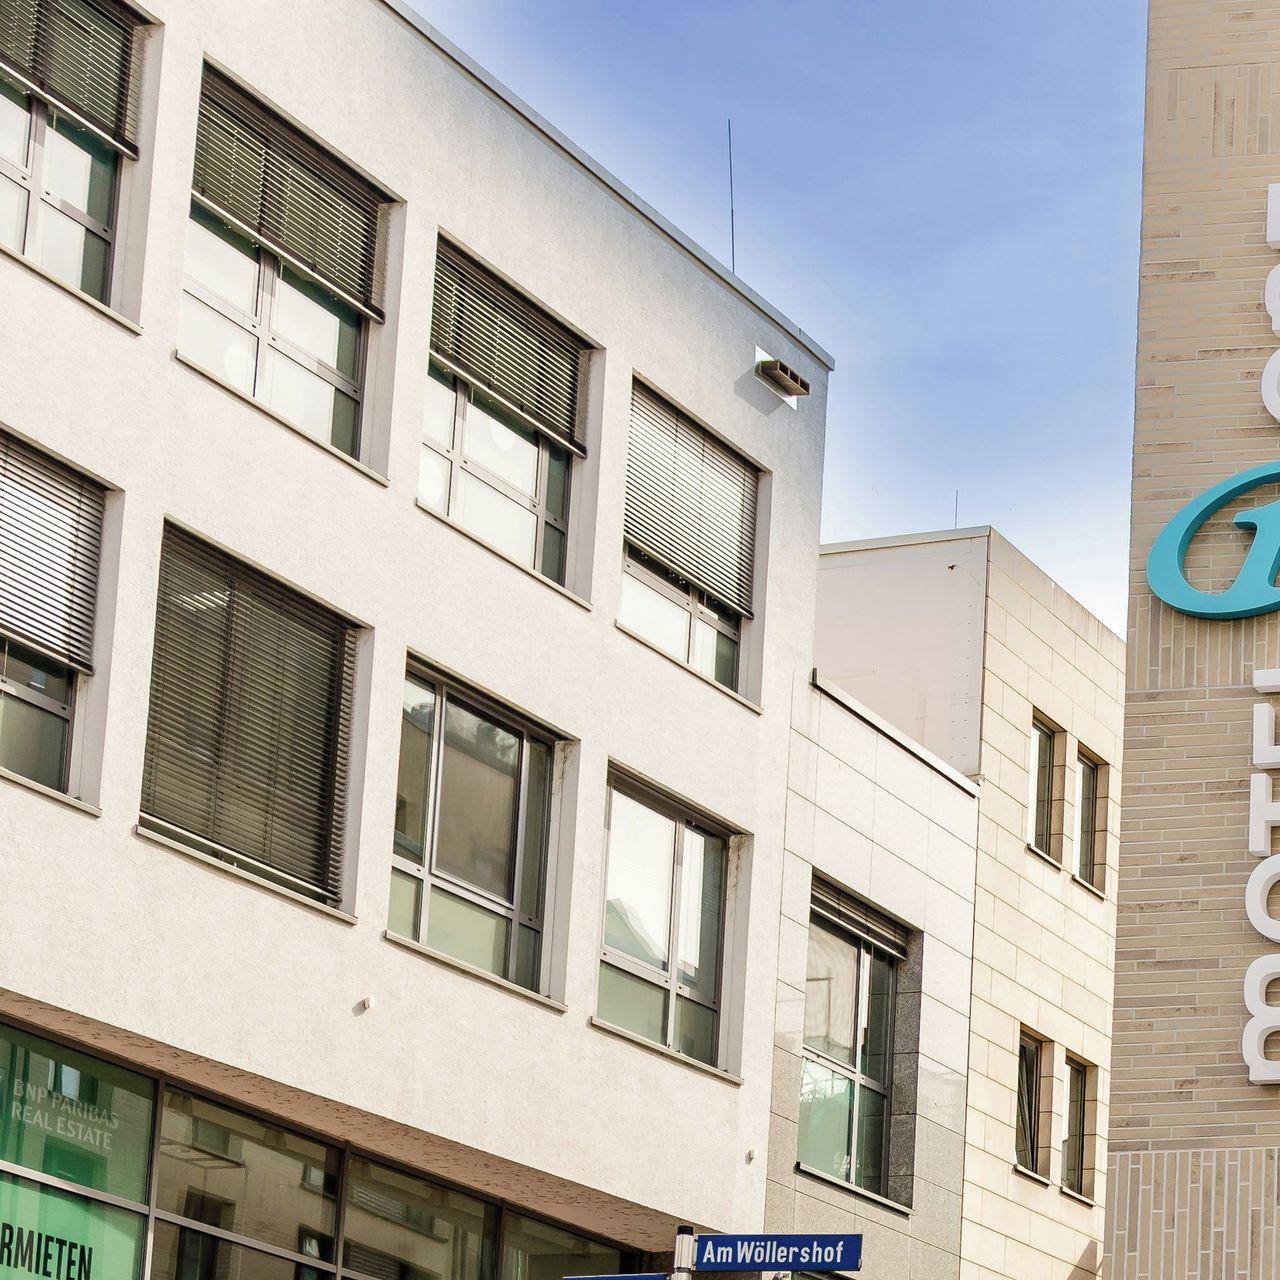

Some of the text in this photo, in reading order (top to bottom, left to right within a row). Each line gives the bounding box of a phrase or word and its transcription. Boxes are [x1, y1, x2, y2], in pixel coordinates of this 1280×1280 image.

[11, 1102, 113, 1150] REAL ESTATE
[13, 1079, 120, 1129] BNP PARIBAS
[702, 1240, 844, 1264] Am Wöllershof
